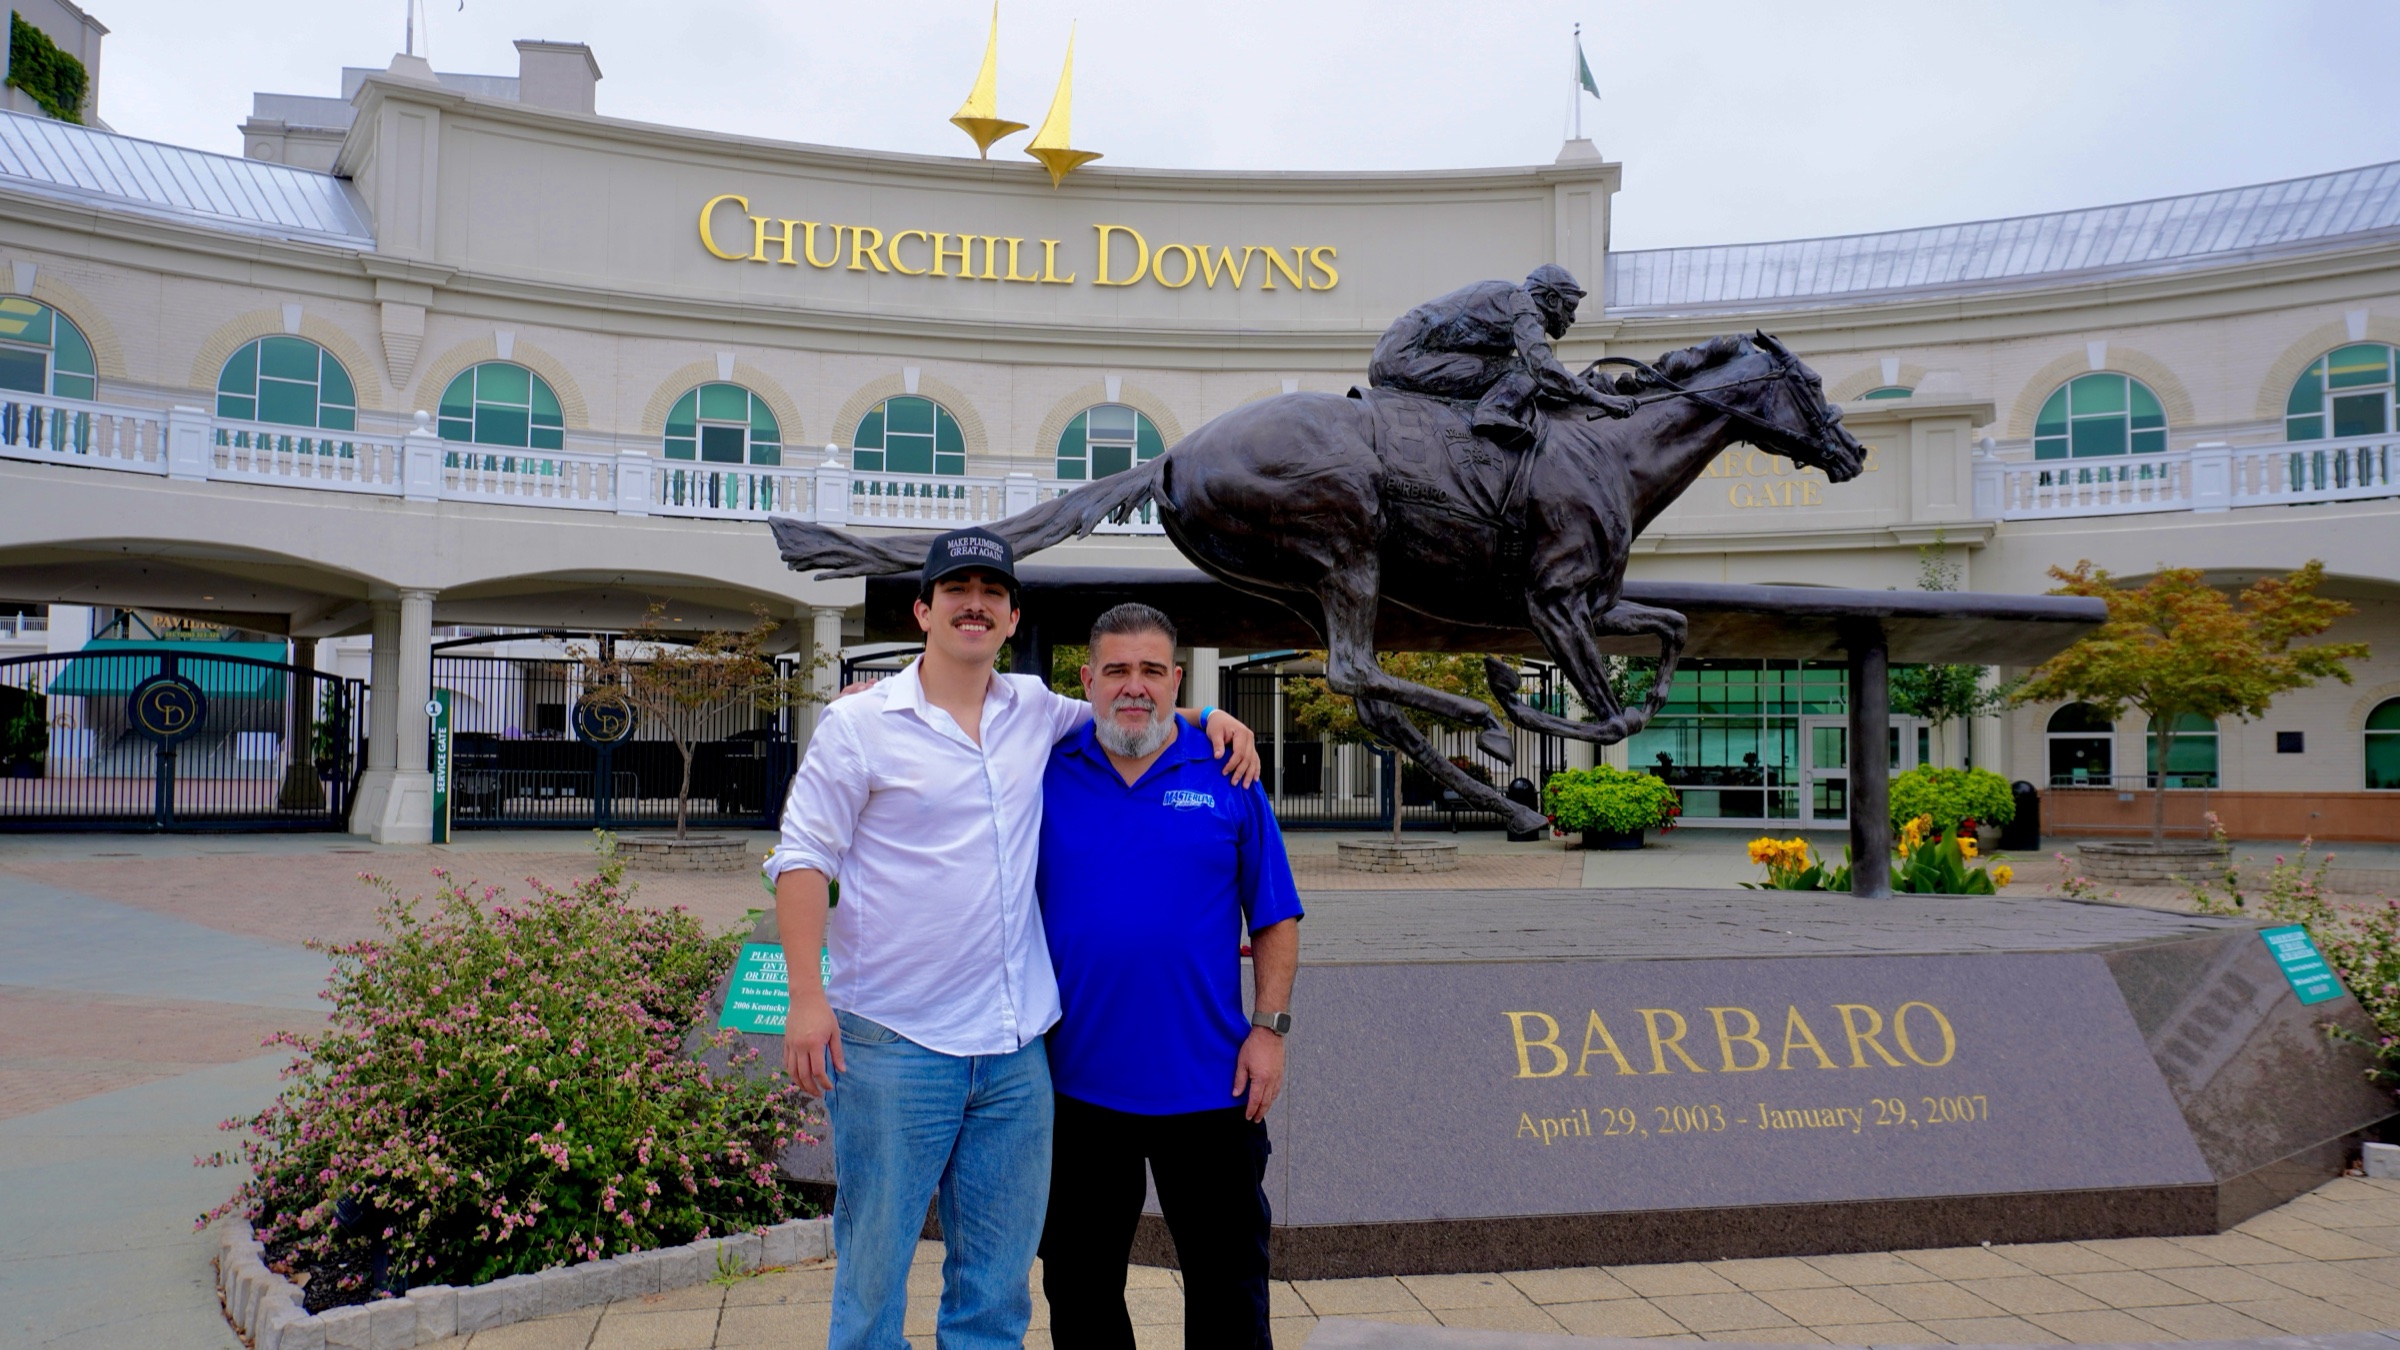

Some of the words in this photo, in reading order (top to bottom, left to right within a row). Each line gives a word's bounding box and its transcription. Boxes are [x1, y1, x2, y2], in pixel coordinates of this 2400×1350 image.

[699, 194, 1075, 284] CHURCHILL
[1092, 224, 1340, 290] DOWNS
[1729, 480, 1823, 509] GATE
[947, 537, 969, 549] MAKE
[969, 537, 1004, 554] PLUMBERS
[950, 546, 978, 557] GREAT
[979, 547, 1002, 562] AGAIN
[430, 703, 438, 714] 1
[438, 727, 447, 752] GATE
[437, 753, 446, 792] SERVICE
[762, 962, 776, 970] ON
[744, 971, 759, 979] OR
[761, 972, 778, 980] THE
[741, 987, 755, 995] This
[762, 988, 772, 996] the
[732, 1001, 750, 1010] 2006
[751, 1002, 786, 1013] Kentucky
[753, 1014, 787, 1025] BARB
[1501, 1001, 1956, 1078] BARBARO
[1516, 1109, 1592, 1145] April
[1600, 1107, 1648, 1139] 29,
[1657, 1104, 1726, 1134] 2003
[1757, 1102, 1863, 1134] January
[1872, 1098, 1919, 1130] 29,
[1927, 1095, 1988, 1124] 2007
